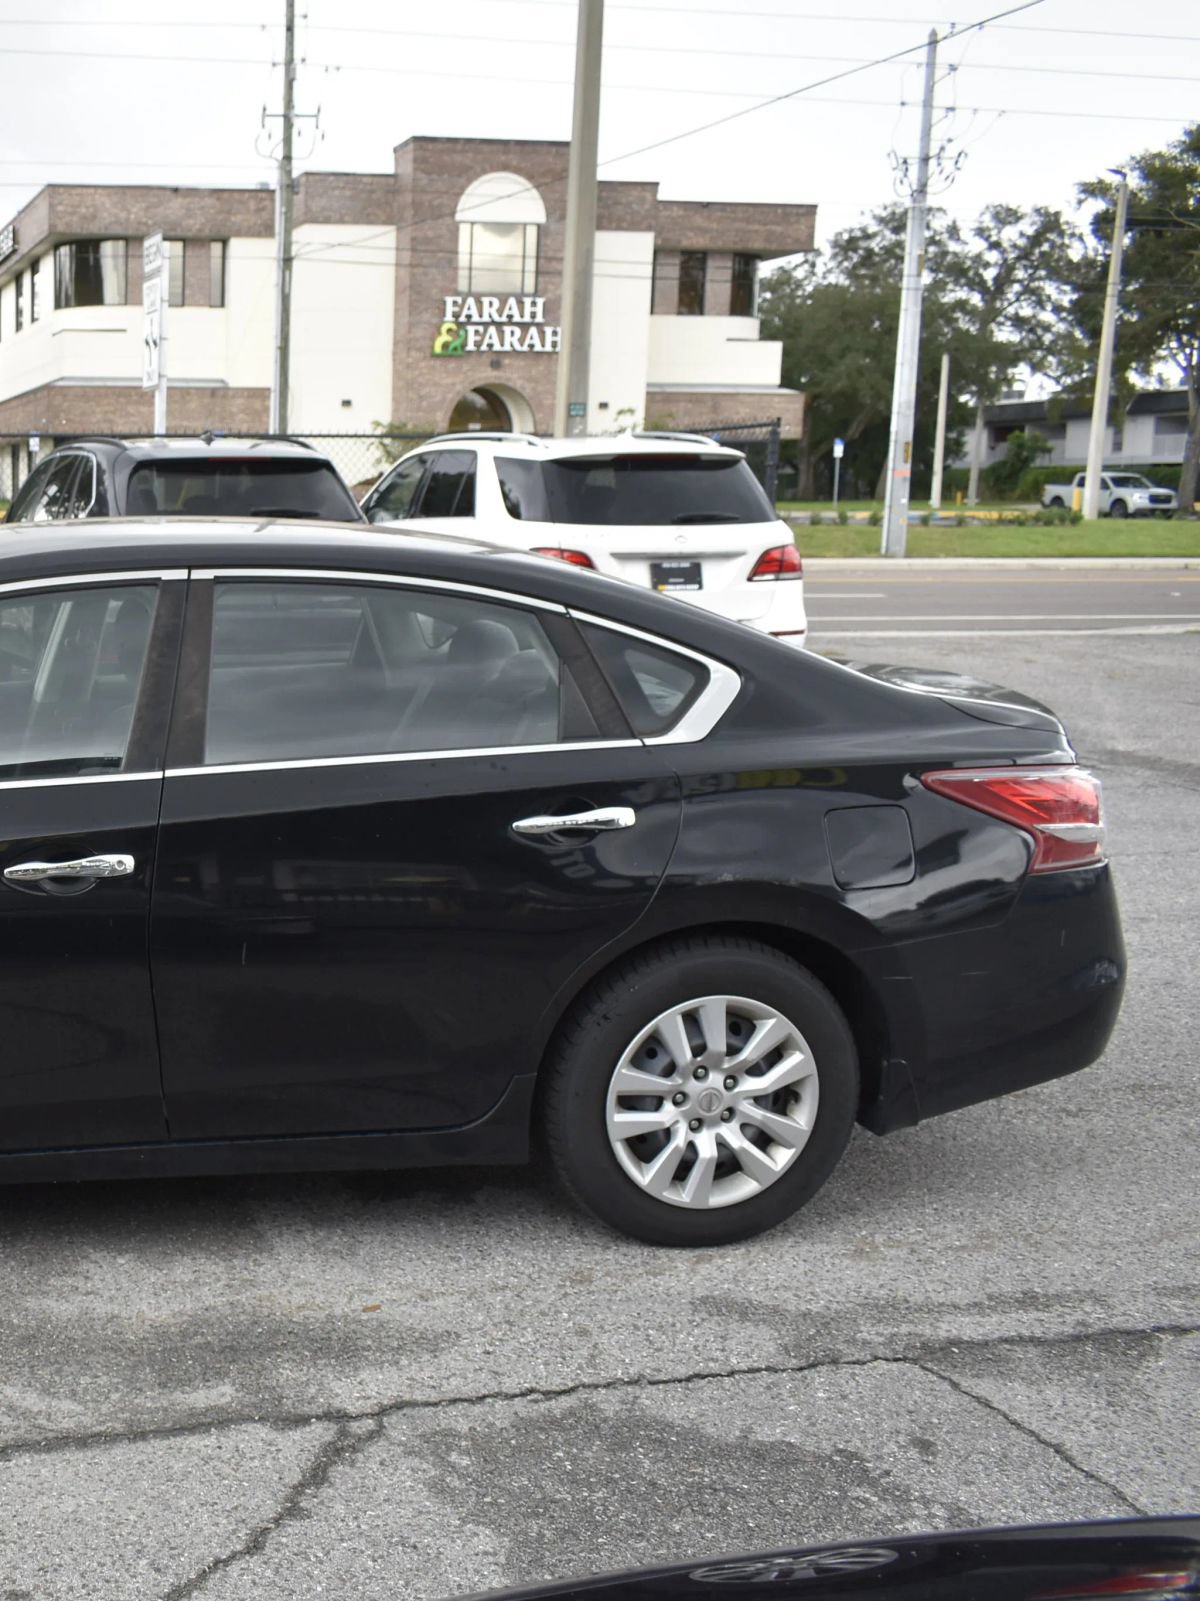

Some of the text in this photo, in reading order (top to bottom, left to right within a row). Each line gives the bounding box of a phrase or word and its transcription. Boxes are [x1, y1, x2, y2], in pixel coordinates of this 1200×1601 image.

[443, 296, 546, 323] FARAH
[432, 322, 562, 356] & FARAH
